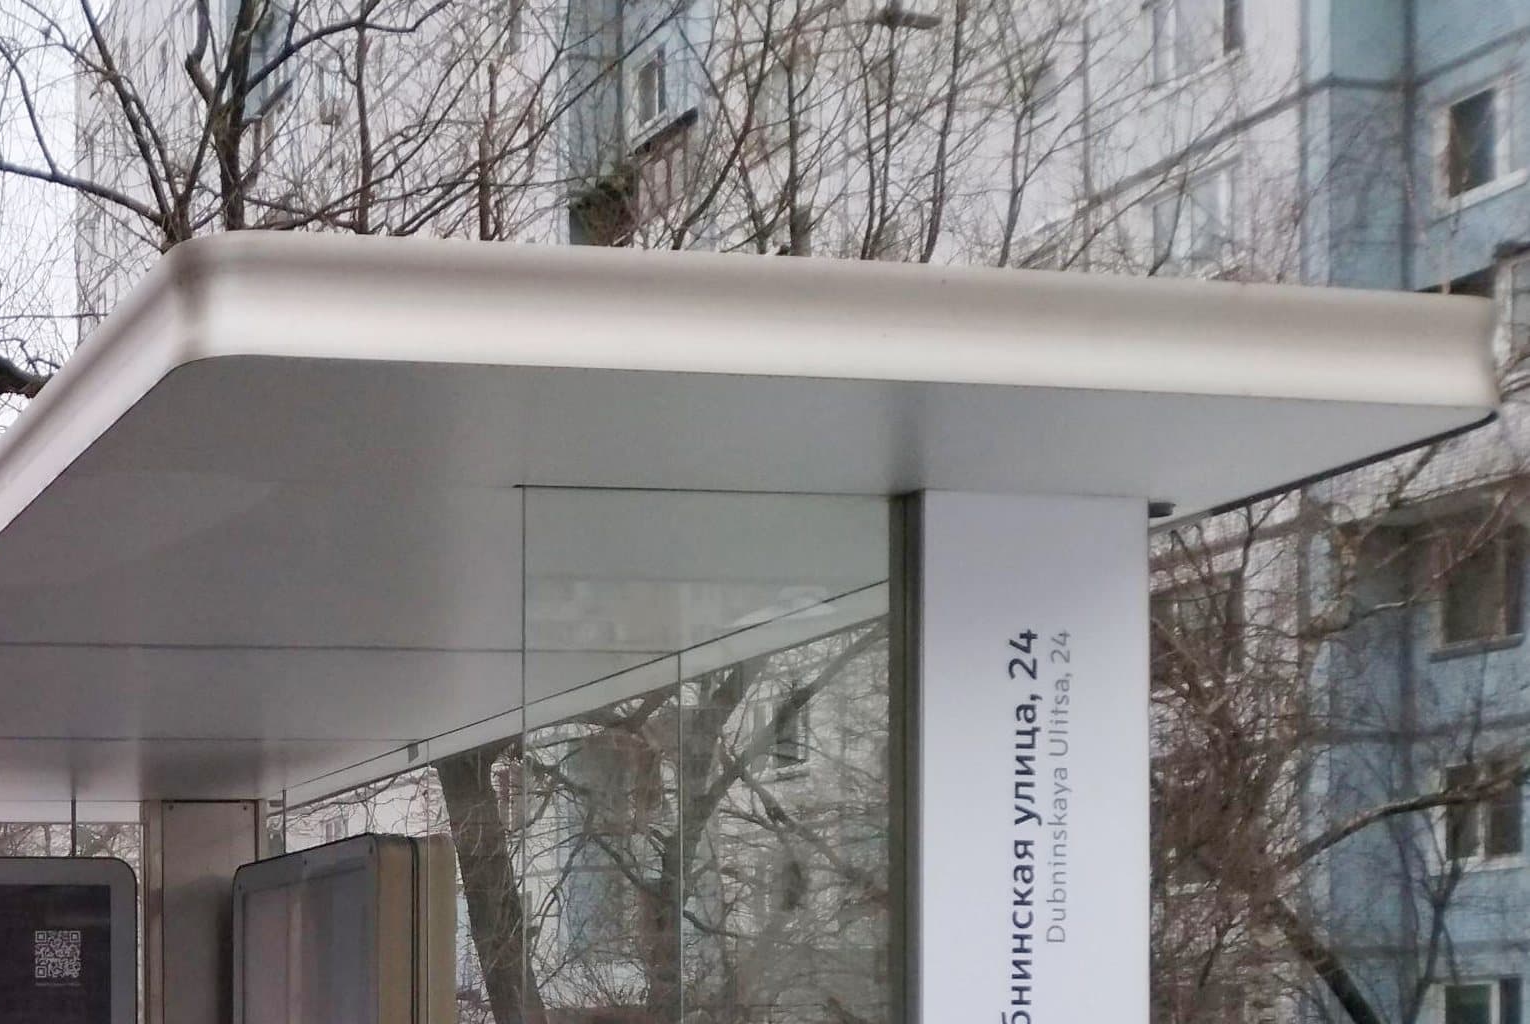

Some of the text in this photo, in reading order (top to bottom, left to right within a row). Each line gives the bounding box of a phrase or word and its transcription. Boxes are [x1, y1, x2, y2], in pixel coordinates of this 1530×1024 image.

[1008, 629, 1039, 680] 24
[1013, 694, 1043, 827] улица,
[1046, 629, 1072, 943] Dubninskaya Ulitsa, 24
